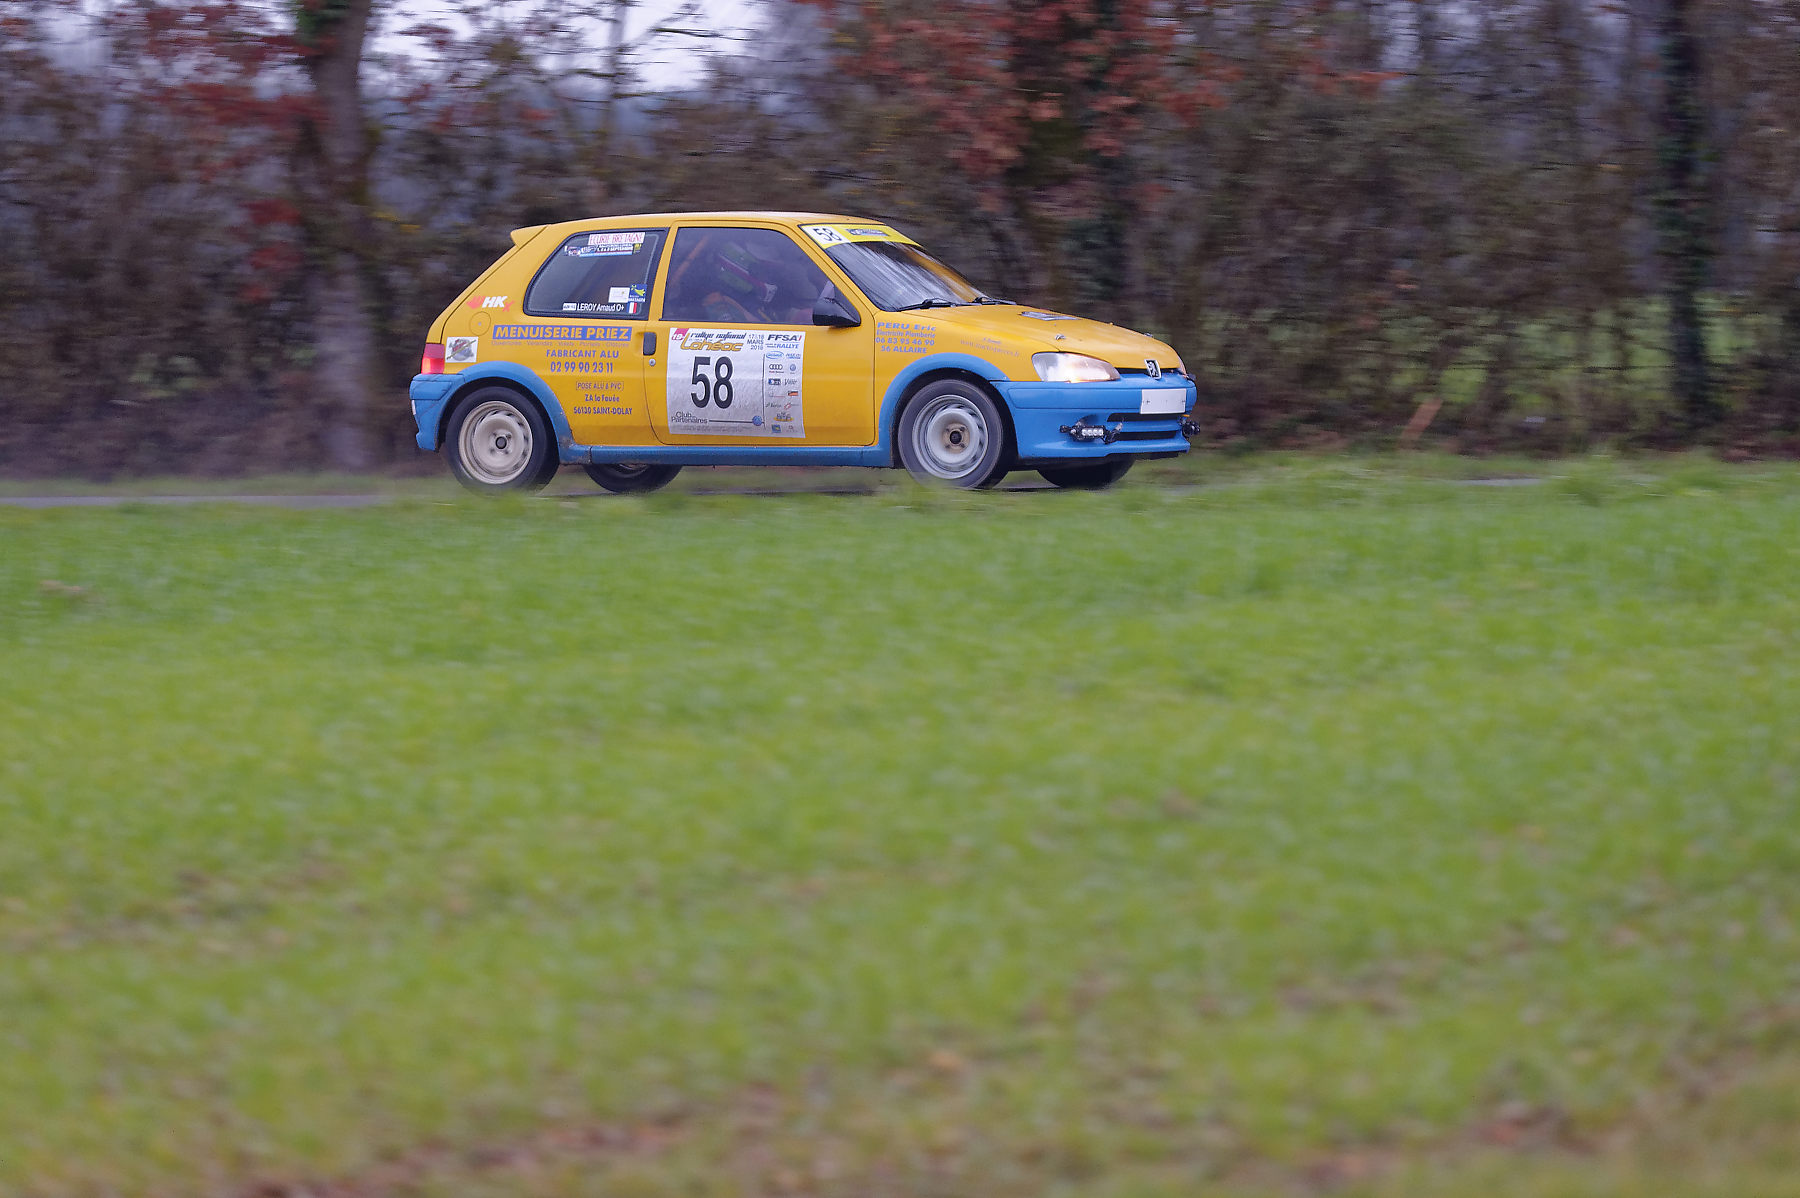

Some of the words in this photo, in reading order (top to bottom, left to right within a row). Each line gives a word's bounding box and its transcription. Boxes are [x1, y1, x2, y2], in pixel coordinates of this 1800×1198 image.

[813, 228, 842, 241] 58
[577, 303, 597, 311] LEROY
[495, 327, 583, 338] MENUISERIE
[586, 328, 629, 339] PRIEZ
[546, 349, 597, 358] FABRICANT
[600, 350, 619, 358] ALU
[550, 361, 562, 373] 02
[564, 361, 576, 373] 99
[579, 362, 590, 373] 90
[592, 362, 604, 373] 23
[606, 362, 613, 373] 11
[691, 356, 733, 409] 58
[573, 406, 592, 414] 56130
[671, 416, 708, 424] Partenaires
